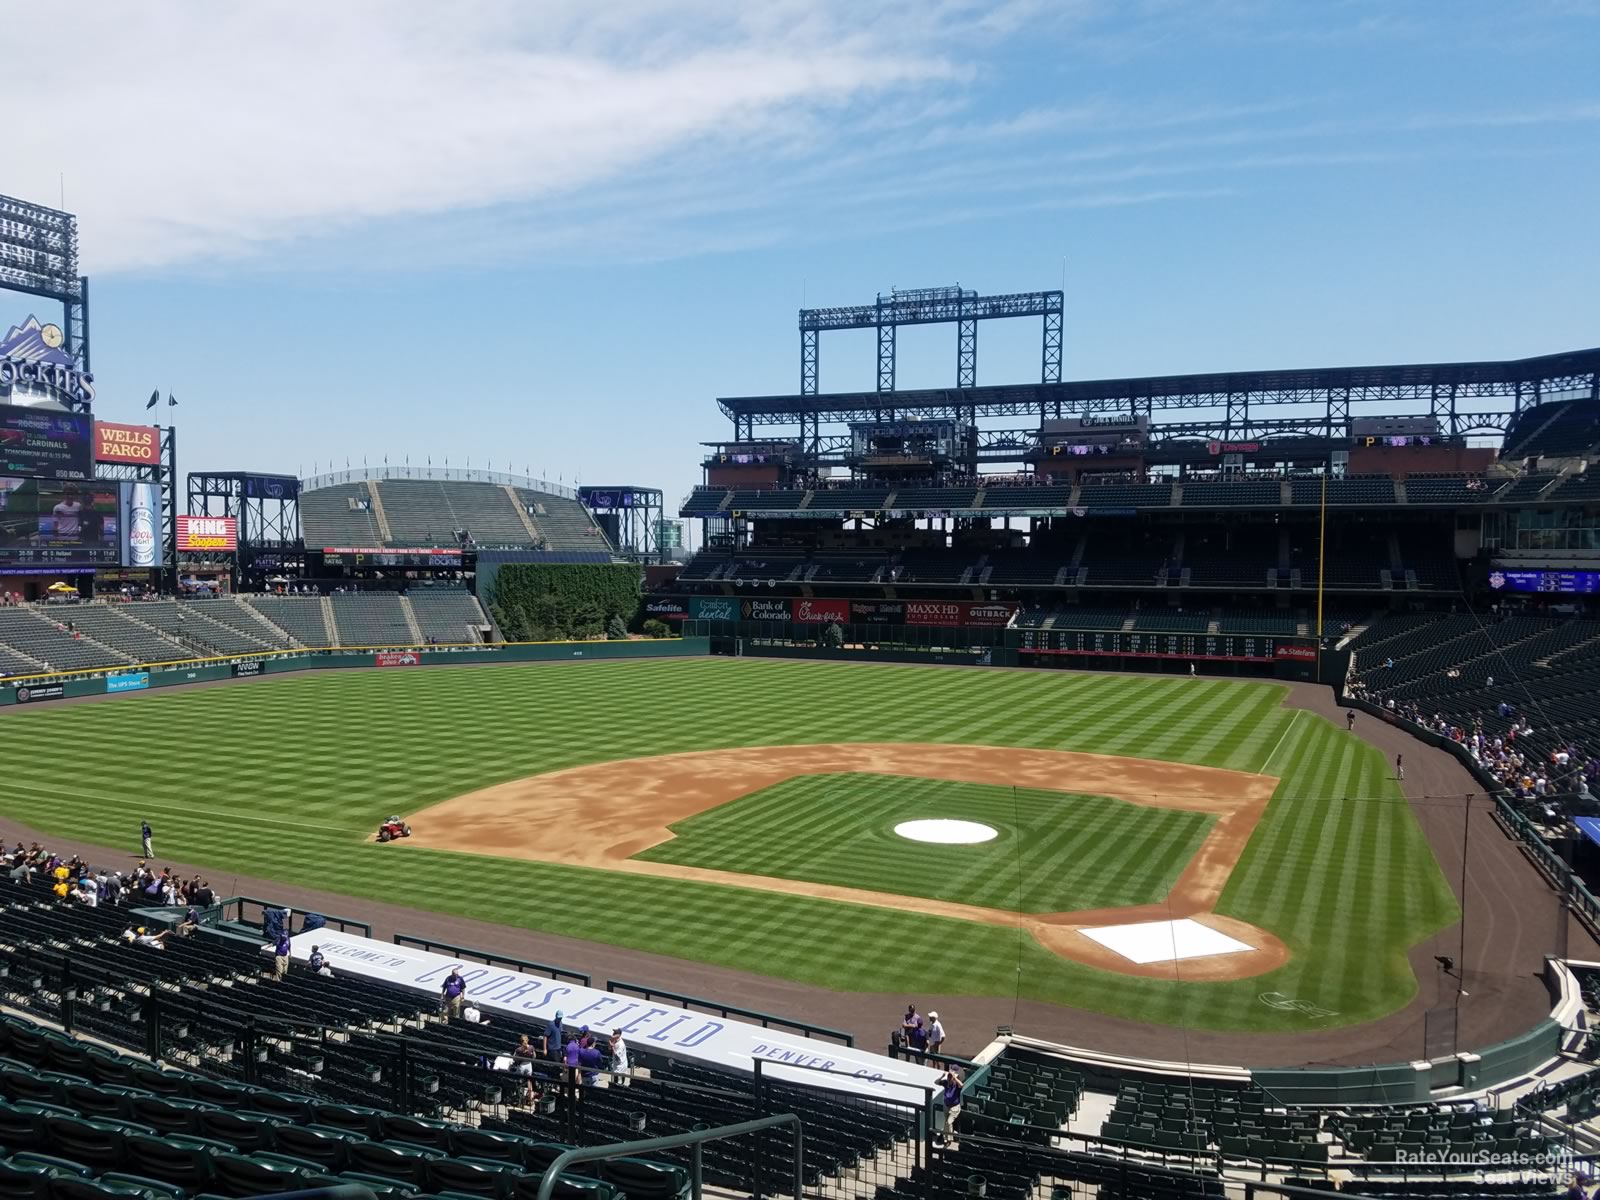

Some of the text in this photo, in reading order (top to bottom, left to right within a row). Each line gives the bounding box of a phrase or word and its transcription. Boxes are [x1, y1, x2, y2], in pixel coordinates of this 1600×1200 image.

[100, 428, 152, 447] WELLS
[26, 439, 68, 449] CARDINALS
[5, 449, 41, 457] TOMORROW
[102, 443, 152, 458] FARGO
[56, 469, 85, 479] 850 KOA
[187, 519, 227, 535] KING
[429, 557, 462, 565] ROCKIES
[646, 603, 683, 612] Safelite
[700, 599, 729, 609] Comfort
[752, 601, 785, 610] Bank of
[699, 606, 730, 619] dental
[752, 609, 792, 619] Colorado
[798, 603, 844, 622] Chick-fil-A
[907, 604, 959, 615] MAXX HD
[970, 610, 1010, 618] OUTBACK
[907, 613, 959, 622] sunglasses
[320, 942, 384, 962] WELCOME
[384, 957, 407, 967] TO
[414, 963, 724, 1048] COORS FIELD
